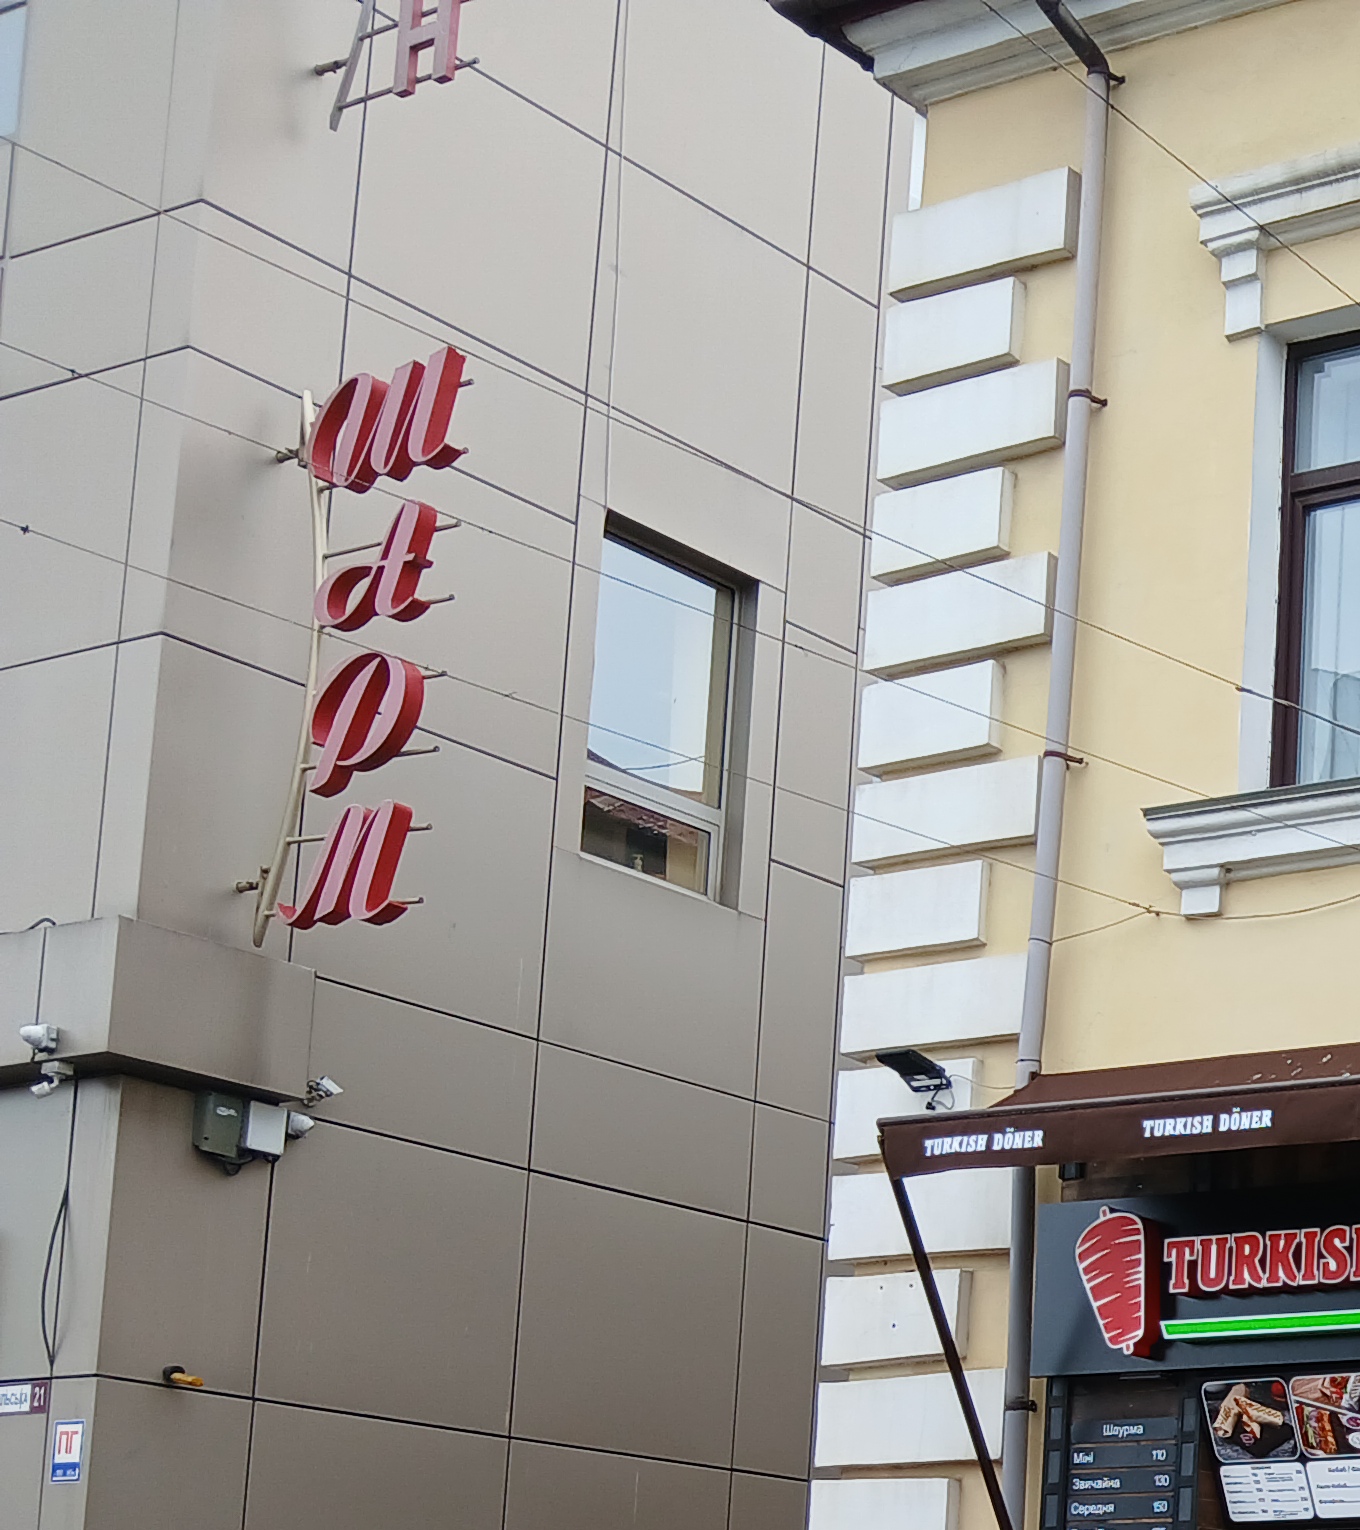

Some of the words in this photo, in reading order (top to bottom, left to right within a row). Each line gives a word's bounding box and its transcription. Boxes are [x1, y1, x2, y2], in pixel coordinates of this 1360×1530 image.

[1143, 1115, 1213, 1139] TURKISH
[1219, 1107, 1273, 1132] DÖNER
[924, 1135, 988, 1157] TURKISH
[992, 1126, 1044, 1151] DÖNER
[33, 1386, 45, 1407] 21
[1102, 1424, 1144, 1438] Шаурма
[1154, 1474, 1169, 1487] 130
[1070, 1502, 1115, 1516] Середня
